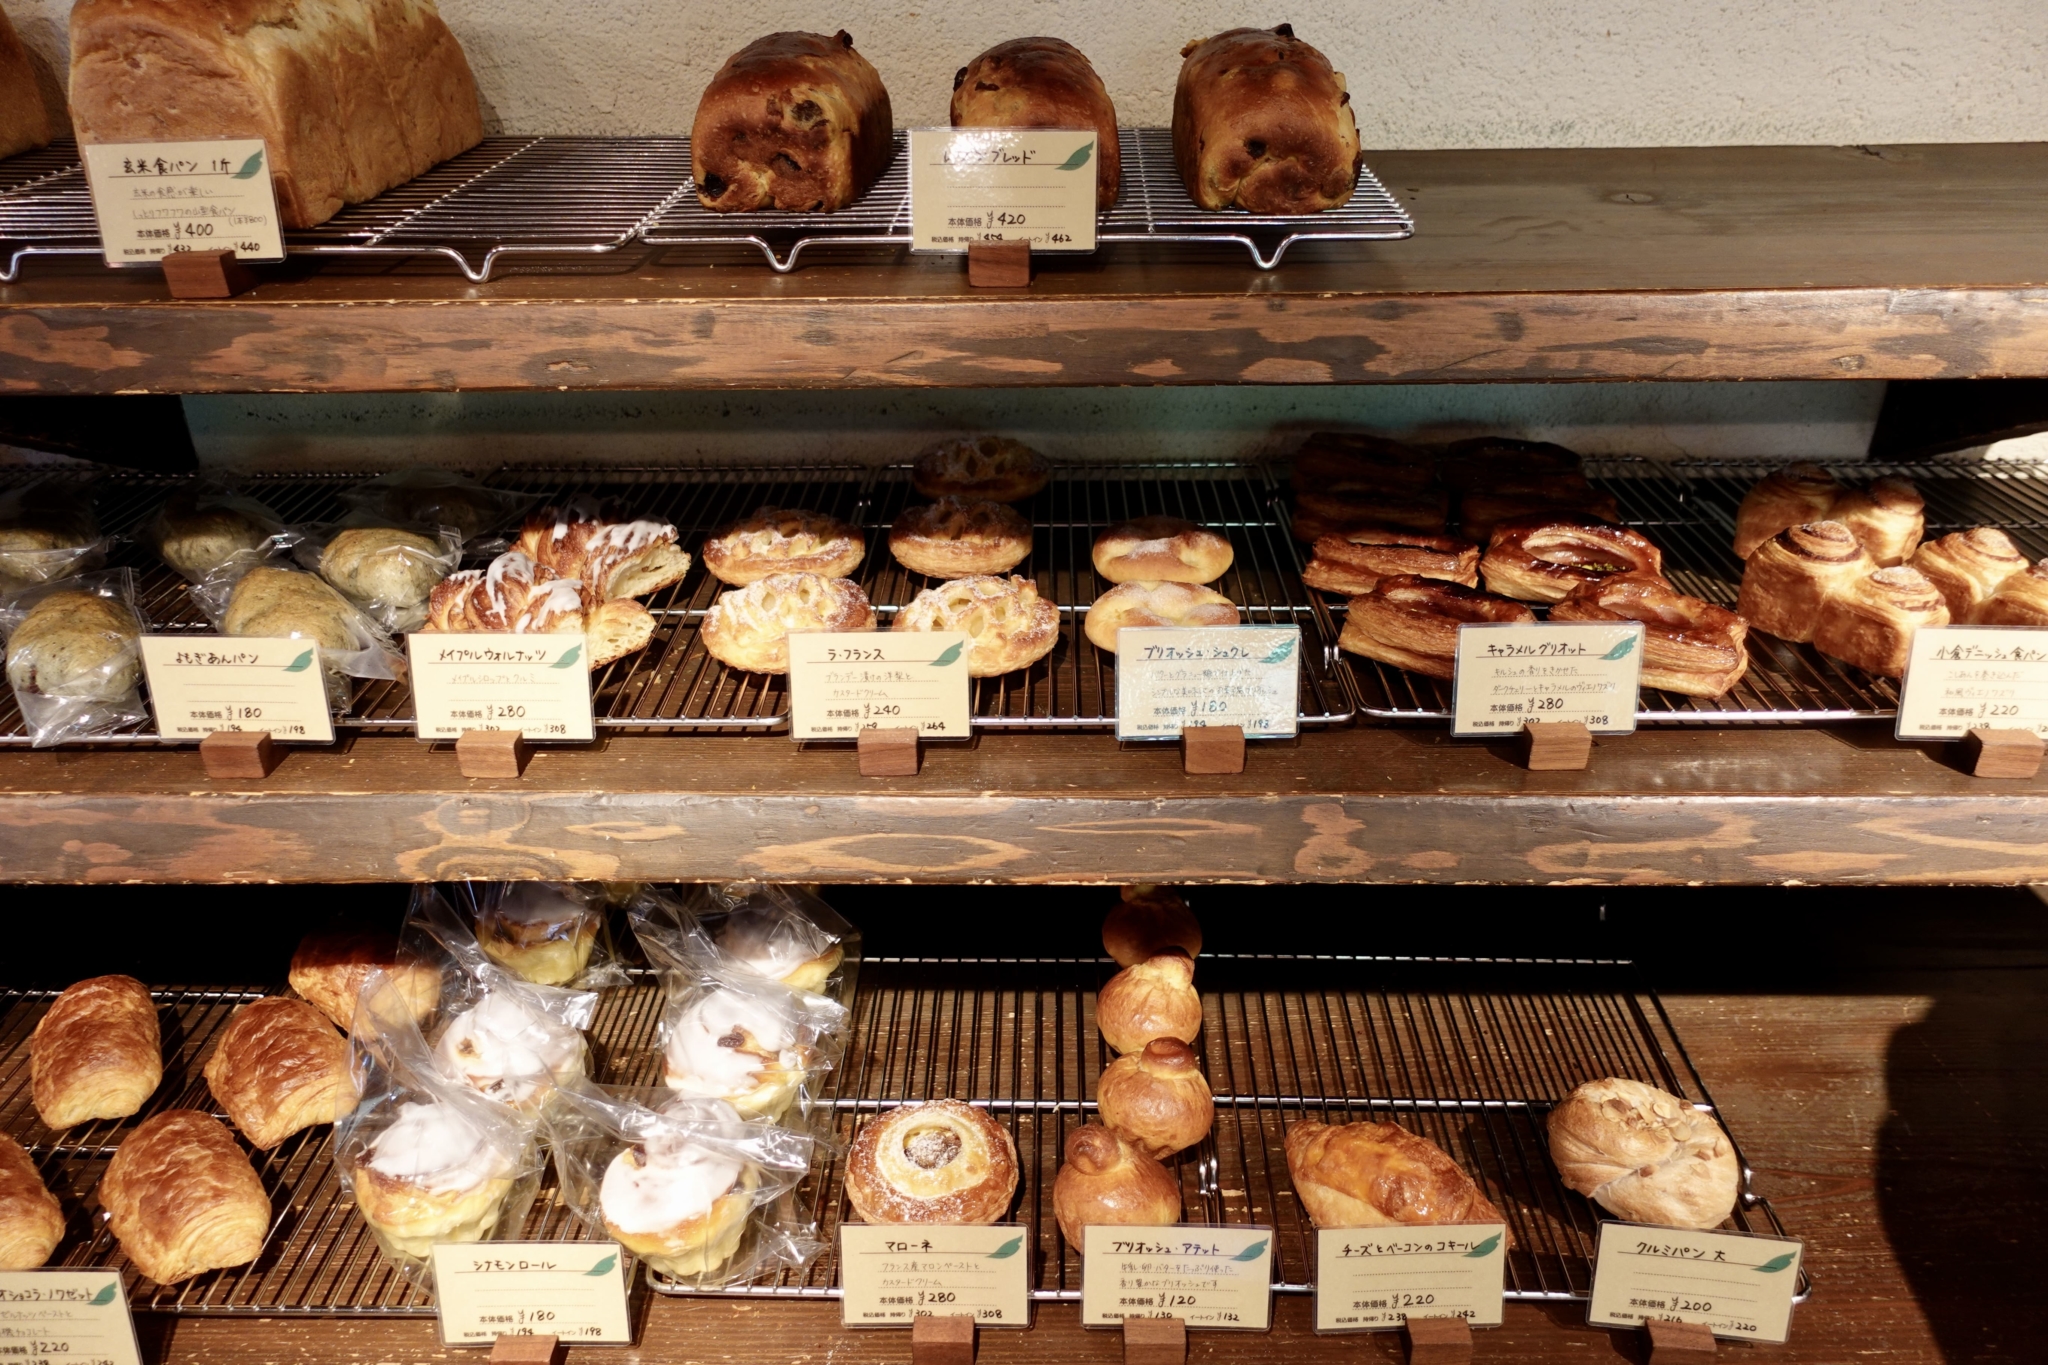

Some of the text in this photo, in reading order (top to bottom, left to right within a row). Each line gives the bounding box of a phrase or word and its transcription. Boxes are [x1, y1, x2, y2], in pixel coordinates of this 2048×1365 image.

[123, 158, 198, 175] 玄米食パン
[948, 211, 1026, 228] 本体価格 ¥420
[137, 222, 213, 239] 本体価格 ¥400
[439, 648, 546, 661] メイプルウォルナッツ
[828, 649, 884, 661] ラ・フランス
[1144, 645, 1249, 659] ブリオッシュ・シュクレ
[1487, 642, 1586, 657] キャラメルグリオット
[1936, 644, 2048, 661] 小倉デニッシュ食パン
[176, 652, 259, 664] よもぎあんパン
[1495, 665, 1579, 676] キルシュの香りをきかせた
[451, 673, 535, 684] メイプルシロップとクルミ
[833, 689, 888, 698] カスタードクリーム
[827, 703, 900, 719] 本体価格 ¥240
[1154, 707, 1186, 715] 本体価格
[1527, 697, 1563, 713] ¥280
[1939, 702, 2019, 718] 本体価格 ¥220
[225, 705, 262, 720] ¥180
[487, 705, 525, 720] ¥280
[885, 1239, 933, 1253] マローネ
[1113, 1241, 1220, 1255] ブリオッシュ・アテット
[1342, 1240, 1480, 1256] チーズとベーコンのコキール
[1636, 1242, 1726, 1261] クルミパン 大
[473, 1260, 557, 1271] シナモンロール
[882, 1261, 980, 1272] フランス産マロンペーストと
[918, 1291, 956, 1305] ¥280
[1158, 1292, 1196, 1307] ¥120
[1353, 1294, 1434, 1309] 本体価格 ¥220
[1630, 1297, 1712, 1312] 本体価格 ¥200
[479, 1310, 555, 1324] 本体価格 ¥180
[1217, 1312, 1239, 1321] ¥132
[1610, 1312, 1633, 1320] 税込価格
[30, 1340, 69, 1355] ¥220
